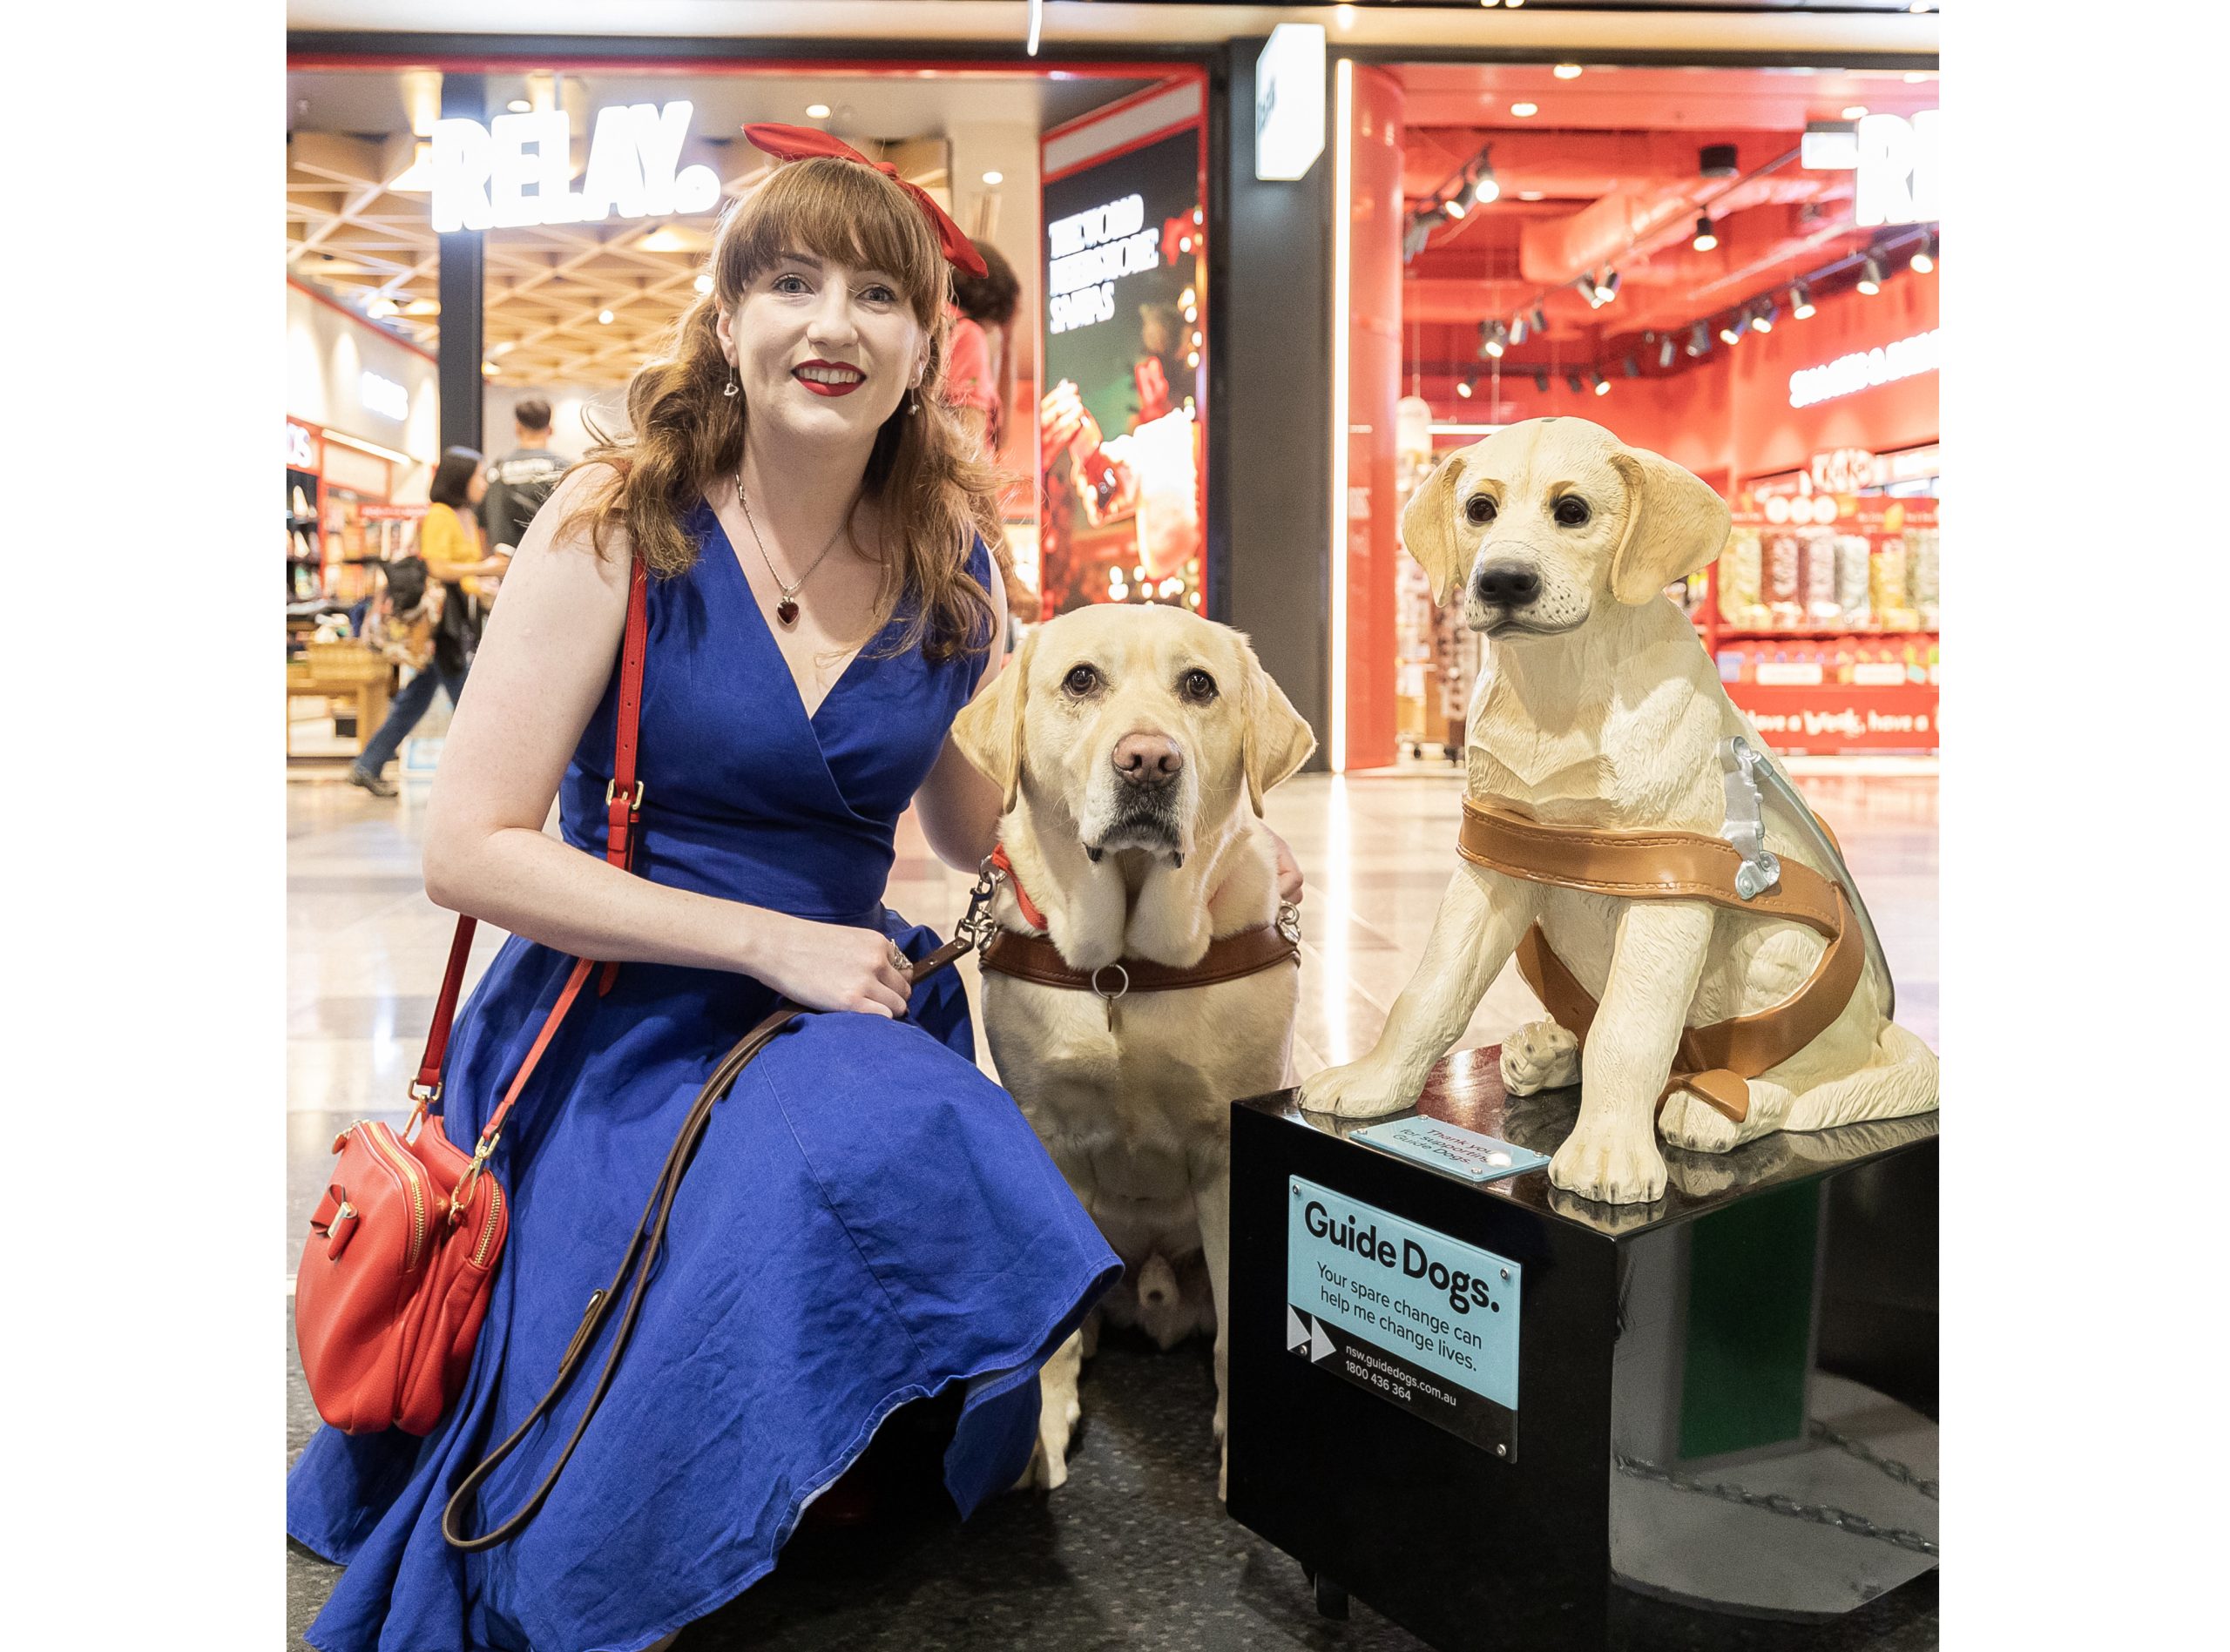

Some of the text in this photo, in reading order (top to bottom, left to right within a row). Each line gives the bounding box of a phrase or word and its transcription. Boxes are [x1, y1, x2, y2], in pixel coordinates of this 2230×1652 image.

[1393, 1134, 1470, 1164] Guide Dogs.
[1427, 1129, 1493, 1155] Thank you
[1304, 1200, 1500, 1315] Guide Dogs.
[1316, 1260, 1482, 1349] Your spare change can
[1321, 1285, 1477, 1372] help me change lives.
[1345, 1345, 1456, 1406] nsw.guidedogs.com.au
[1345, 1360, 1411, 1401] 1800 436 364
